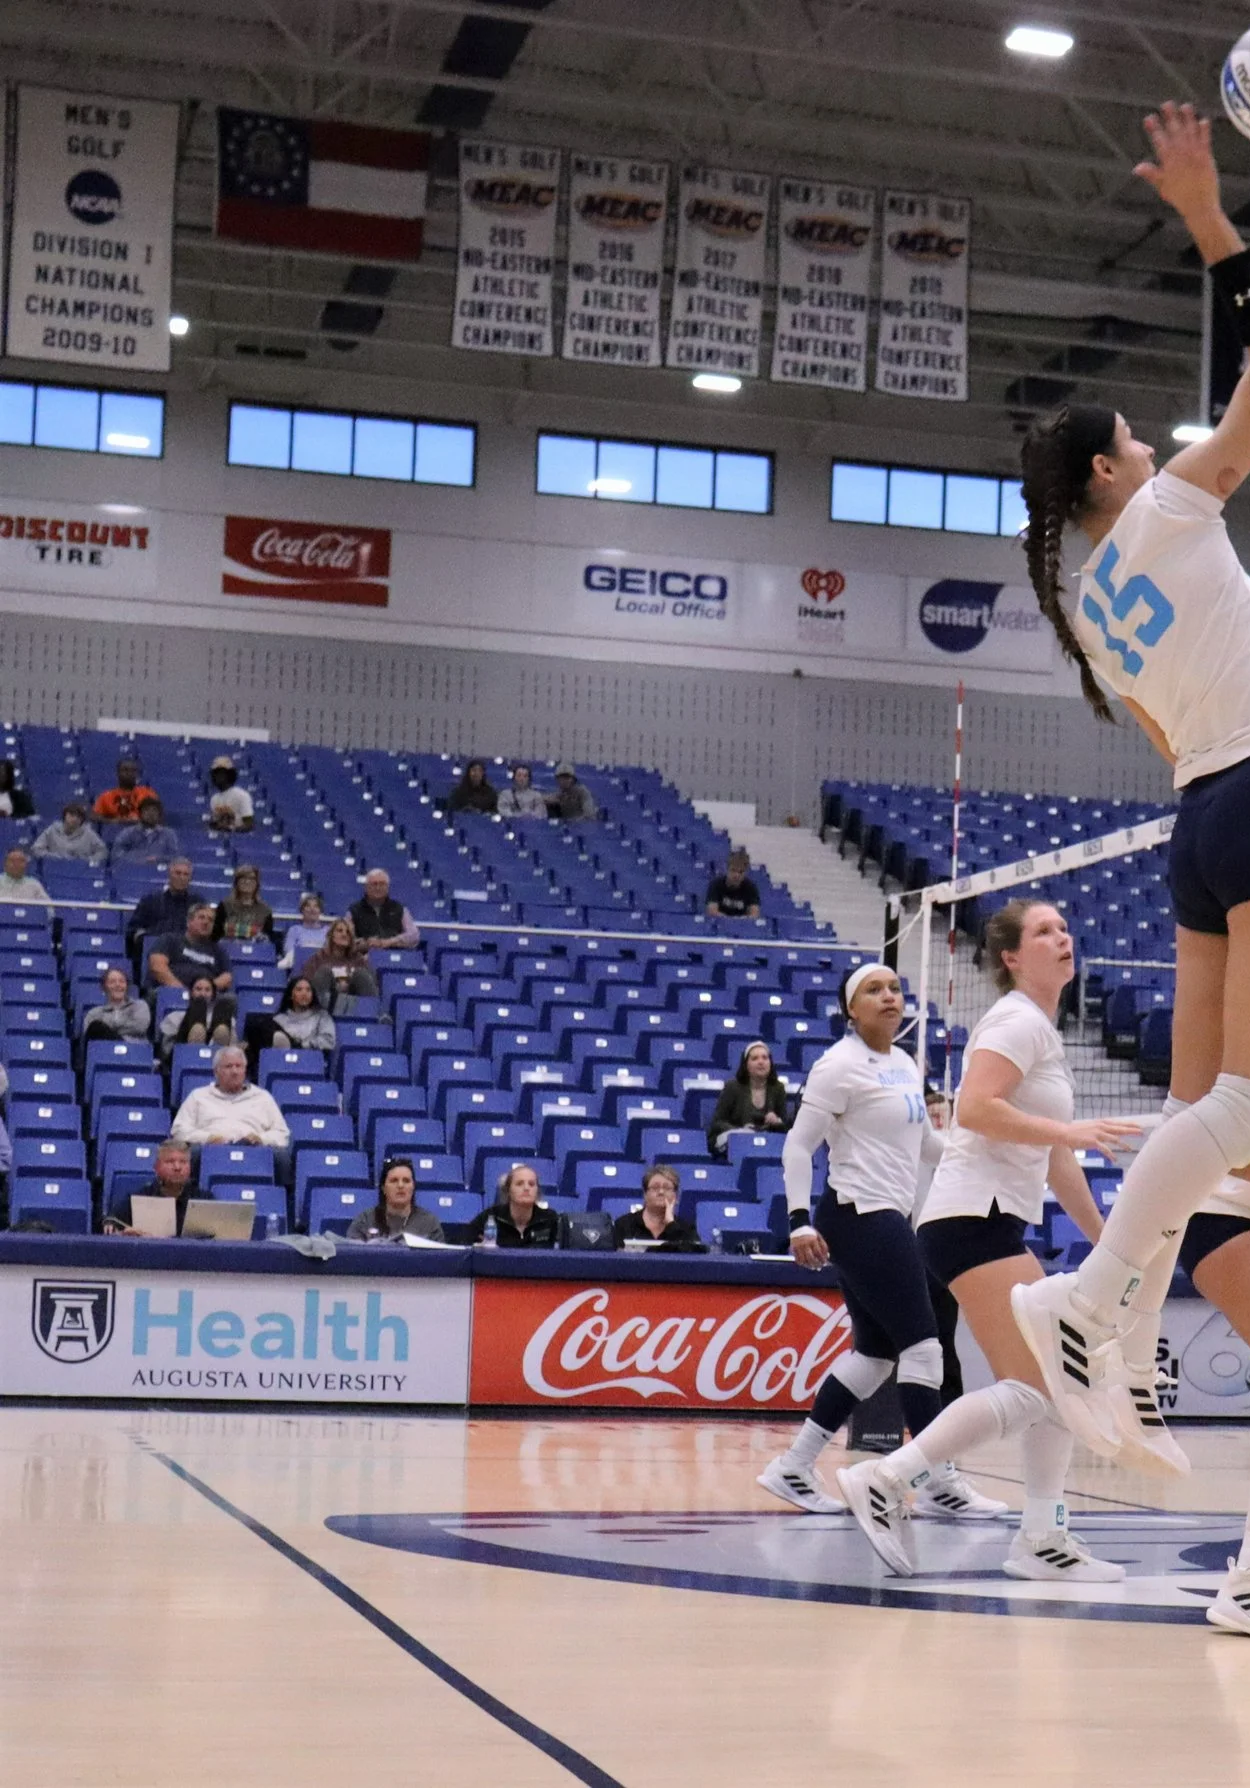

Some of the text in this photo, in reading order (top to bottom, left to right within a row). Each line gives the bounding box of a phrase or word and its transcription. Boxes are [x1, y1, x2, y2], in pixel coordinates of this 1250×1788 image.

[64, 104, 131, 131] MEN'S
[67, 135, 125, 159] GOLF
[32, 231, 153, 265] DIVISION I
[34, 265, 144, 296] NATIONAL
[472, 275, 540, 299] ATHLETIC
[25, 295, 154, 328] CHAMPIONS
[460, 300, 548, 326] CONFERENCE
[582, 289, 648, 313] ATHLETIC
[686, 295, 749, 321] ATHLETIC
[570, 313, 655, 338] CONFERENCE
[673, 320, 758, 346] CONFERENCE
[791, 312, 855, 335] ATHLETIC
[891, 323, 953, 347] ATHLETIC
[42, 328, 137, 357] 2009-10
[462, 326, 543, 351] CHAMPIONS
[574, 337, 650, 362] CHAMPIONS
[778, 334, 863, 361] CONFERENCE
[677, 345, 752, 371] CHAMPIONS
[881, 347, 962, 373] CONFERENCE
[781, 359, 857, 386] CHAMPIONS
[884, 369, 957, 396] CHAMPIONS
[0, 515, 149, 550] DISCOUNT
[35, 546, 104, 566] TIRE
[252, 527, 359, 569] Coca-Cola
[583, 563, 728, 600] GEICO
[615, 597, 727, 621] Local Office
[798, 604, 845, 620] iHeart
[921, 603, 1042, 631] smartwater
[1082, 539, 1175, 678] 15
[132, 1288, 409, 1362] Health
[522, 1288, 853, 1402] Coca-Col
[132, 1369, 408, 1393] AUGUSTA UNIVERSITY
